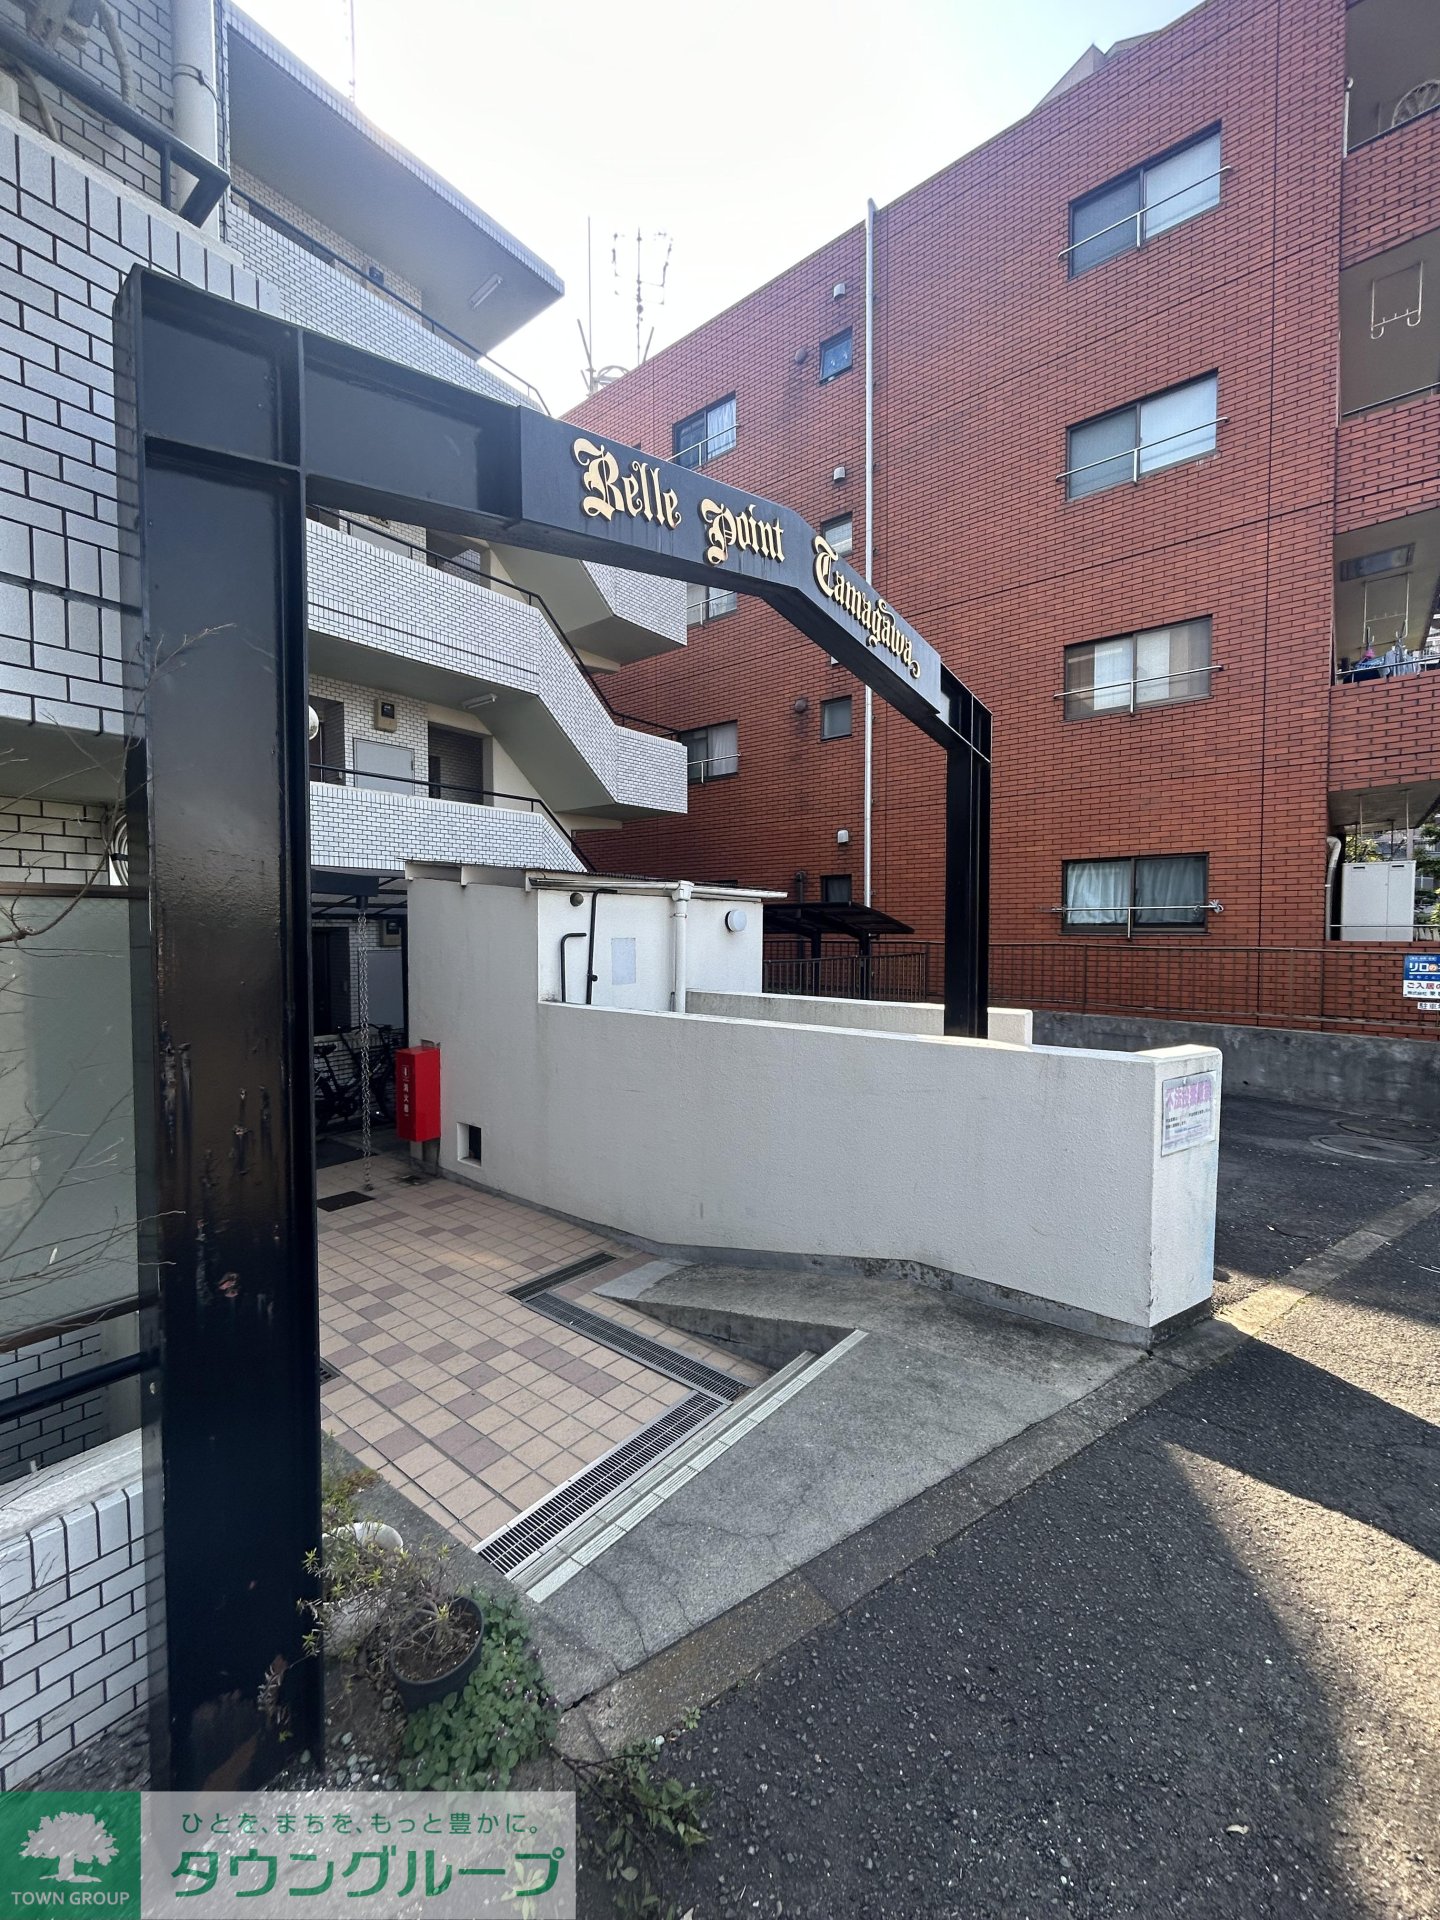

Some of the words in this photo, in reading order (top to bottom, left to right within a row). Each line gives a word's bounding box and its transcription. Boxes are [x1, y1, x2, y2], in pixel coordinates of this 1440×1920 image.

[574, 438, 682, 529] Belle
[700, 498, 786, 565] Point
[813, 535, 921, 678] Tamagawa
[1409, 962, 1440, 972] リロの
